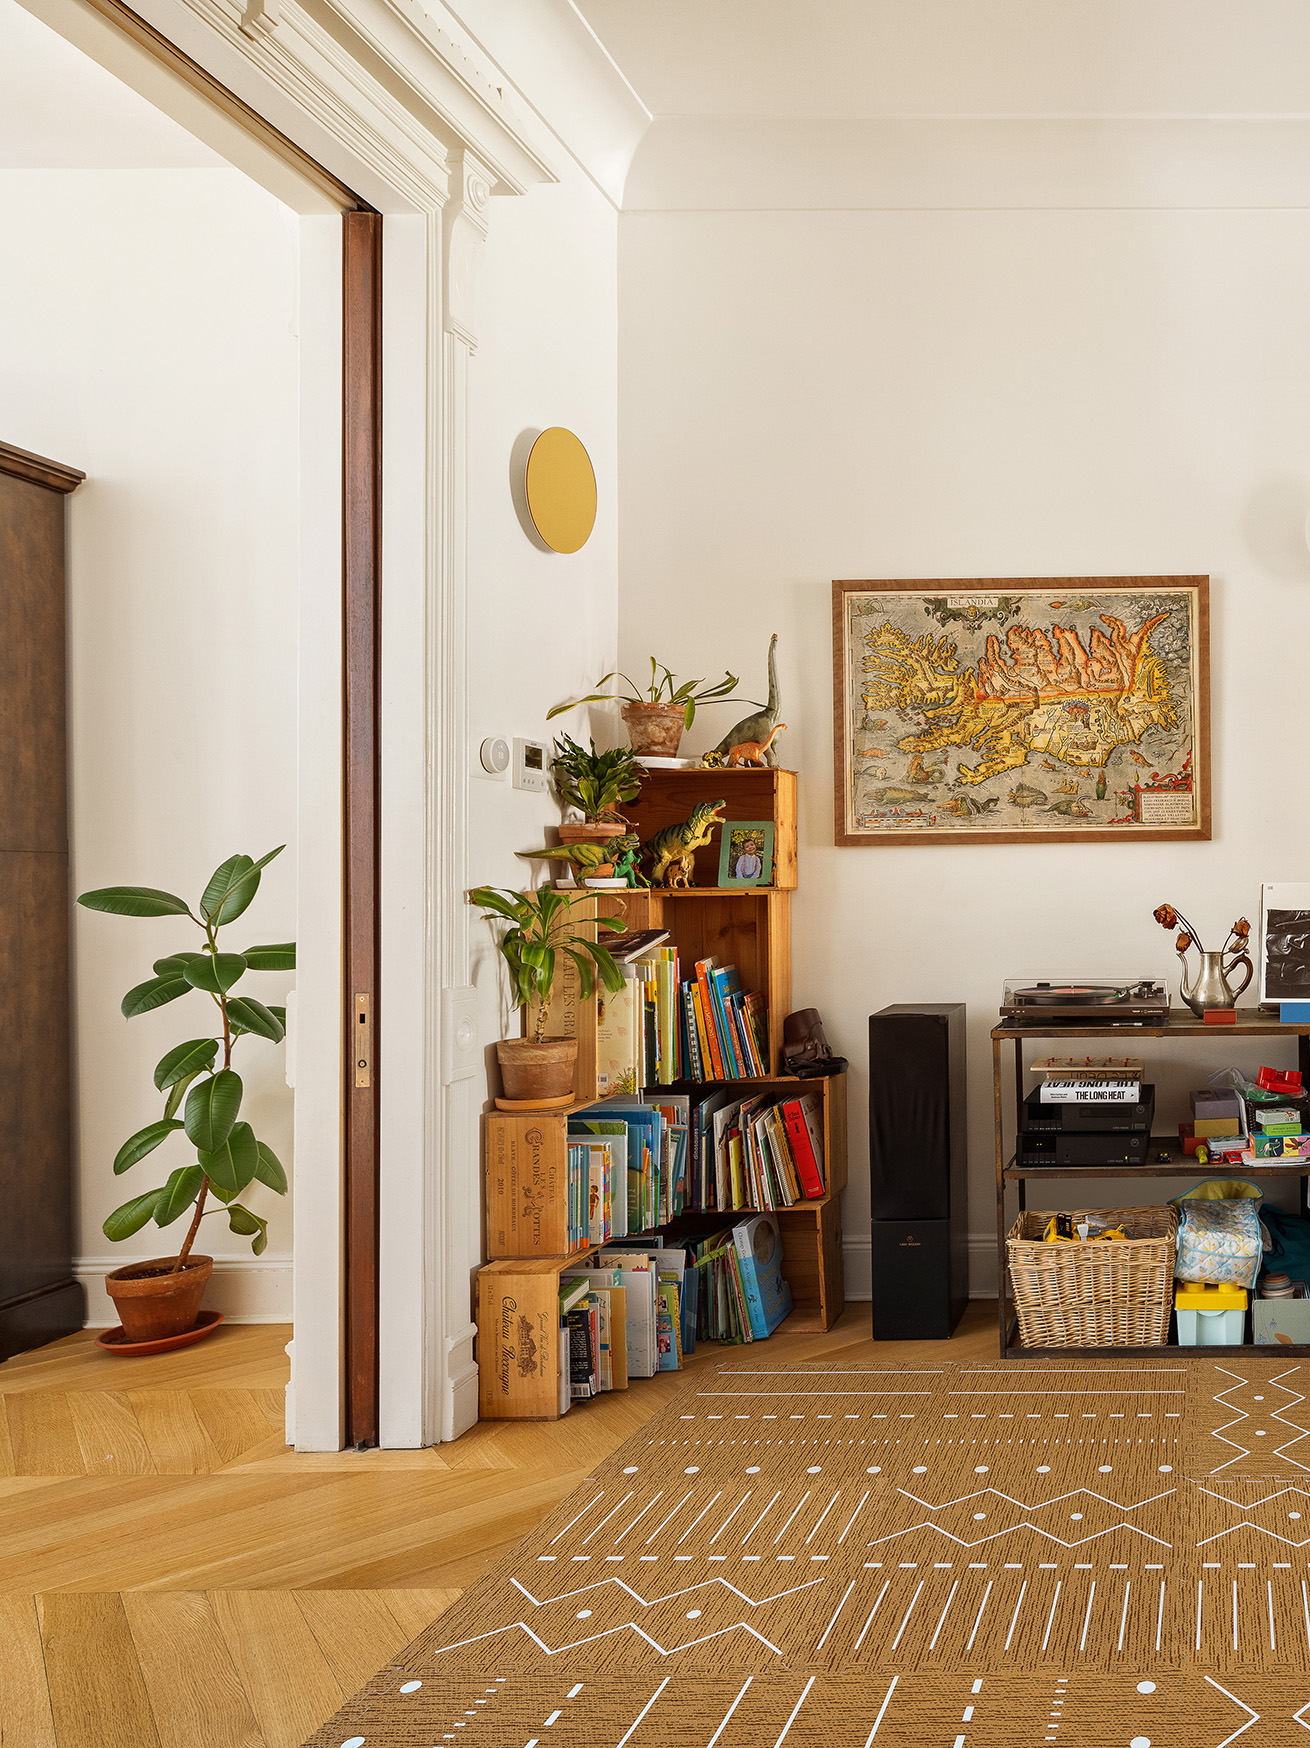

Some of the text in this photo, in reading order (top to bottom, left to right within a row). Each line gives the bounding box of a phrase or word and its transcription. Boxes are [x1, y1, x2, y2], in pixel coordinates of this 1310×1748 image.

[563, 986, 575, 1007] LES
[1075, 1091, 1089, 1100] THE
[1089, 1091, 1108, 1100] LONG
[1108, 1091, 1126, 1100] HEAT
[511, 1188, 517, 1197] DE
[522, 1127, 545, 1246] GRANDES MOTTES
[548, 1166, 557, 1205] CHÂTEAU
[537, 1311, 549, 1333] Grand
[498, 1296, 517, 1396] Château Recougne
[539, 1333, 549, 1344] Vin
